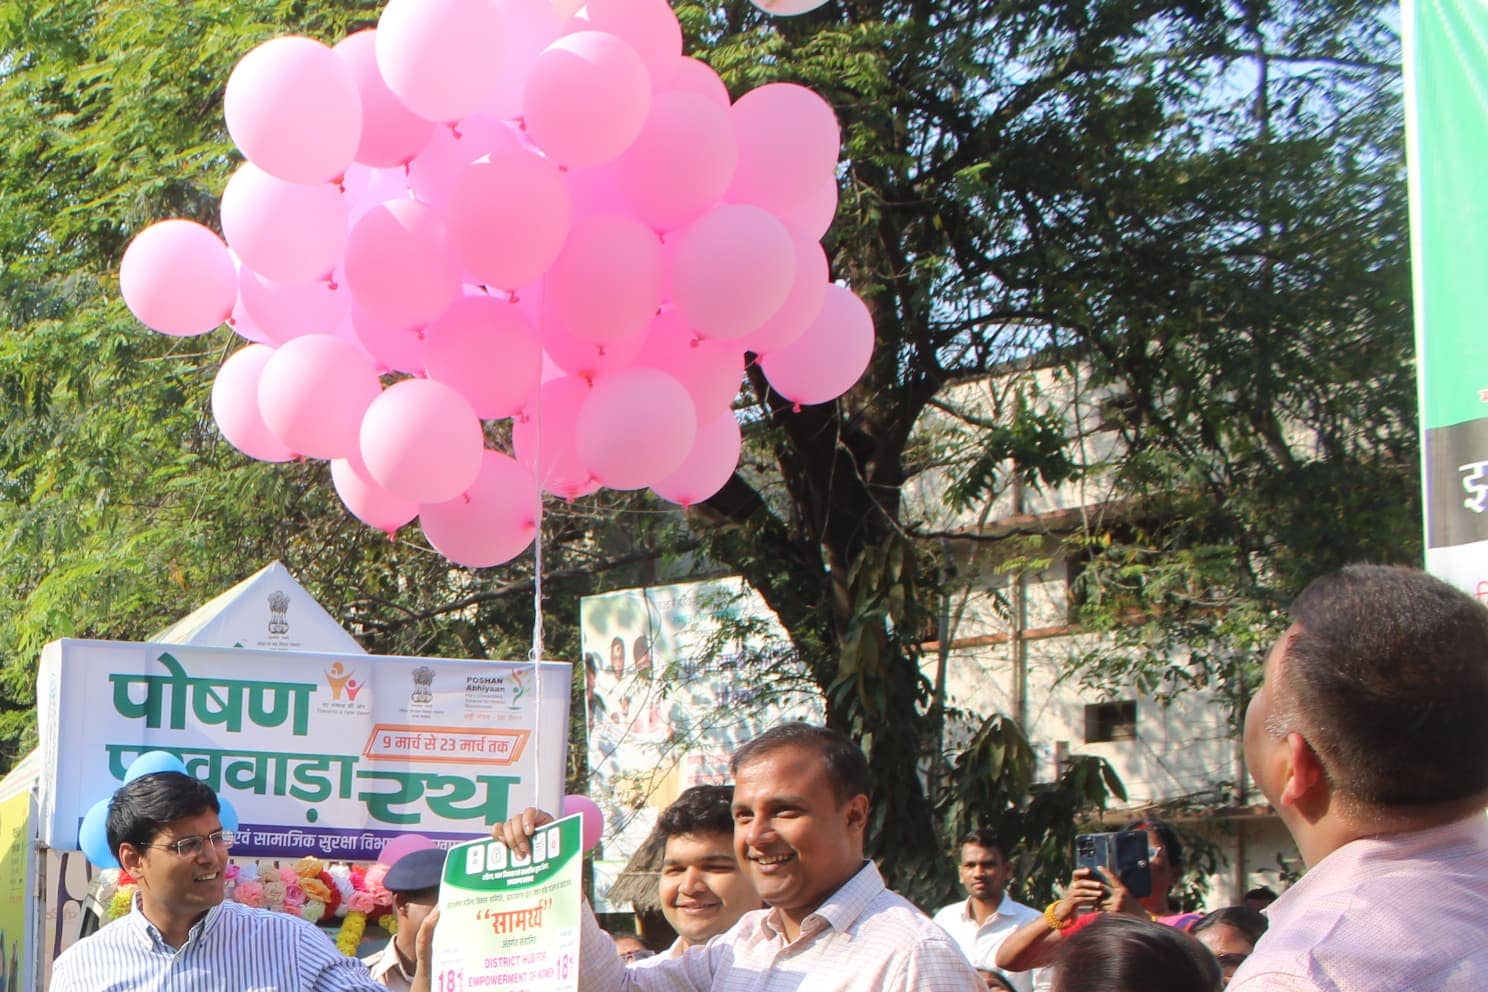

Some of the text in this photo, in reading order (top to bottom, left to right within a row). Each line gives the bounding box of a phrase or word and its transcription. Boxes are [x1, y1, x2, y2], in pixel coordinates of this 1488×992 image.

[466, 676, 504, 684] POSHAN
[466, 684, 505, 693] Abhiyaan
[109, 652, 318, 736] पोषण
[383, 733, 509, 754] 9 मार्च से 23 मार्च तक
[357, 769, 521, 827] रथ
[253, 830, 316, 848] सामाजिक
[318, 833, 358, 853] सुरक्षा
[360, 833, 390, 851] विभा
[484, 955, 520, 969] DISTRICT
[468, 971, 527, 988] EMPOWERMENT
